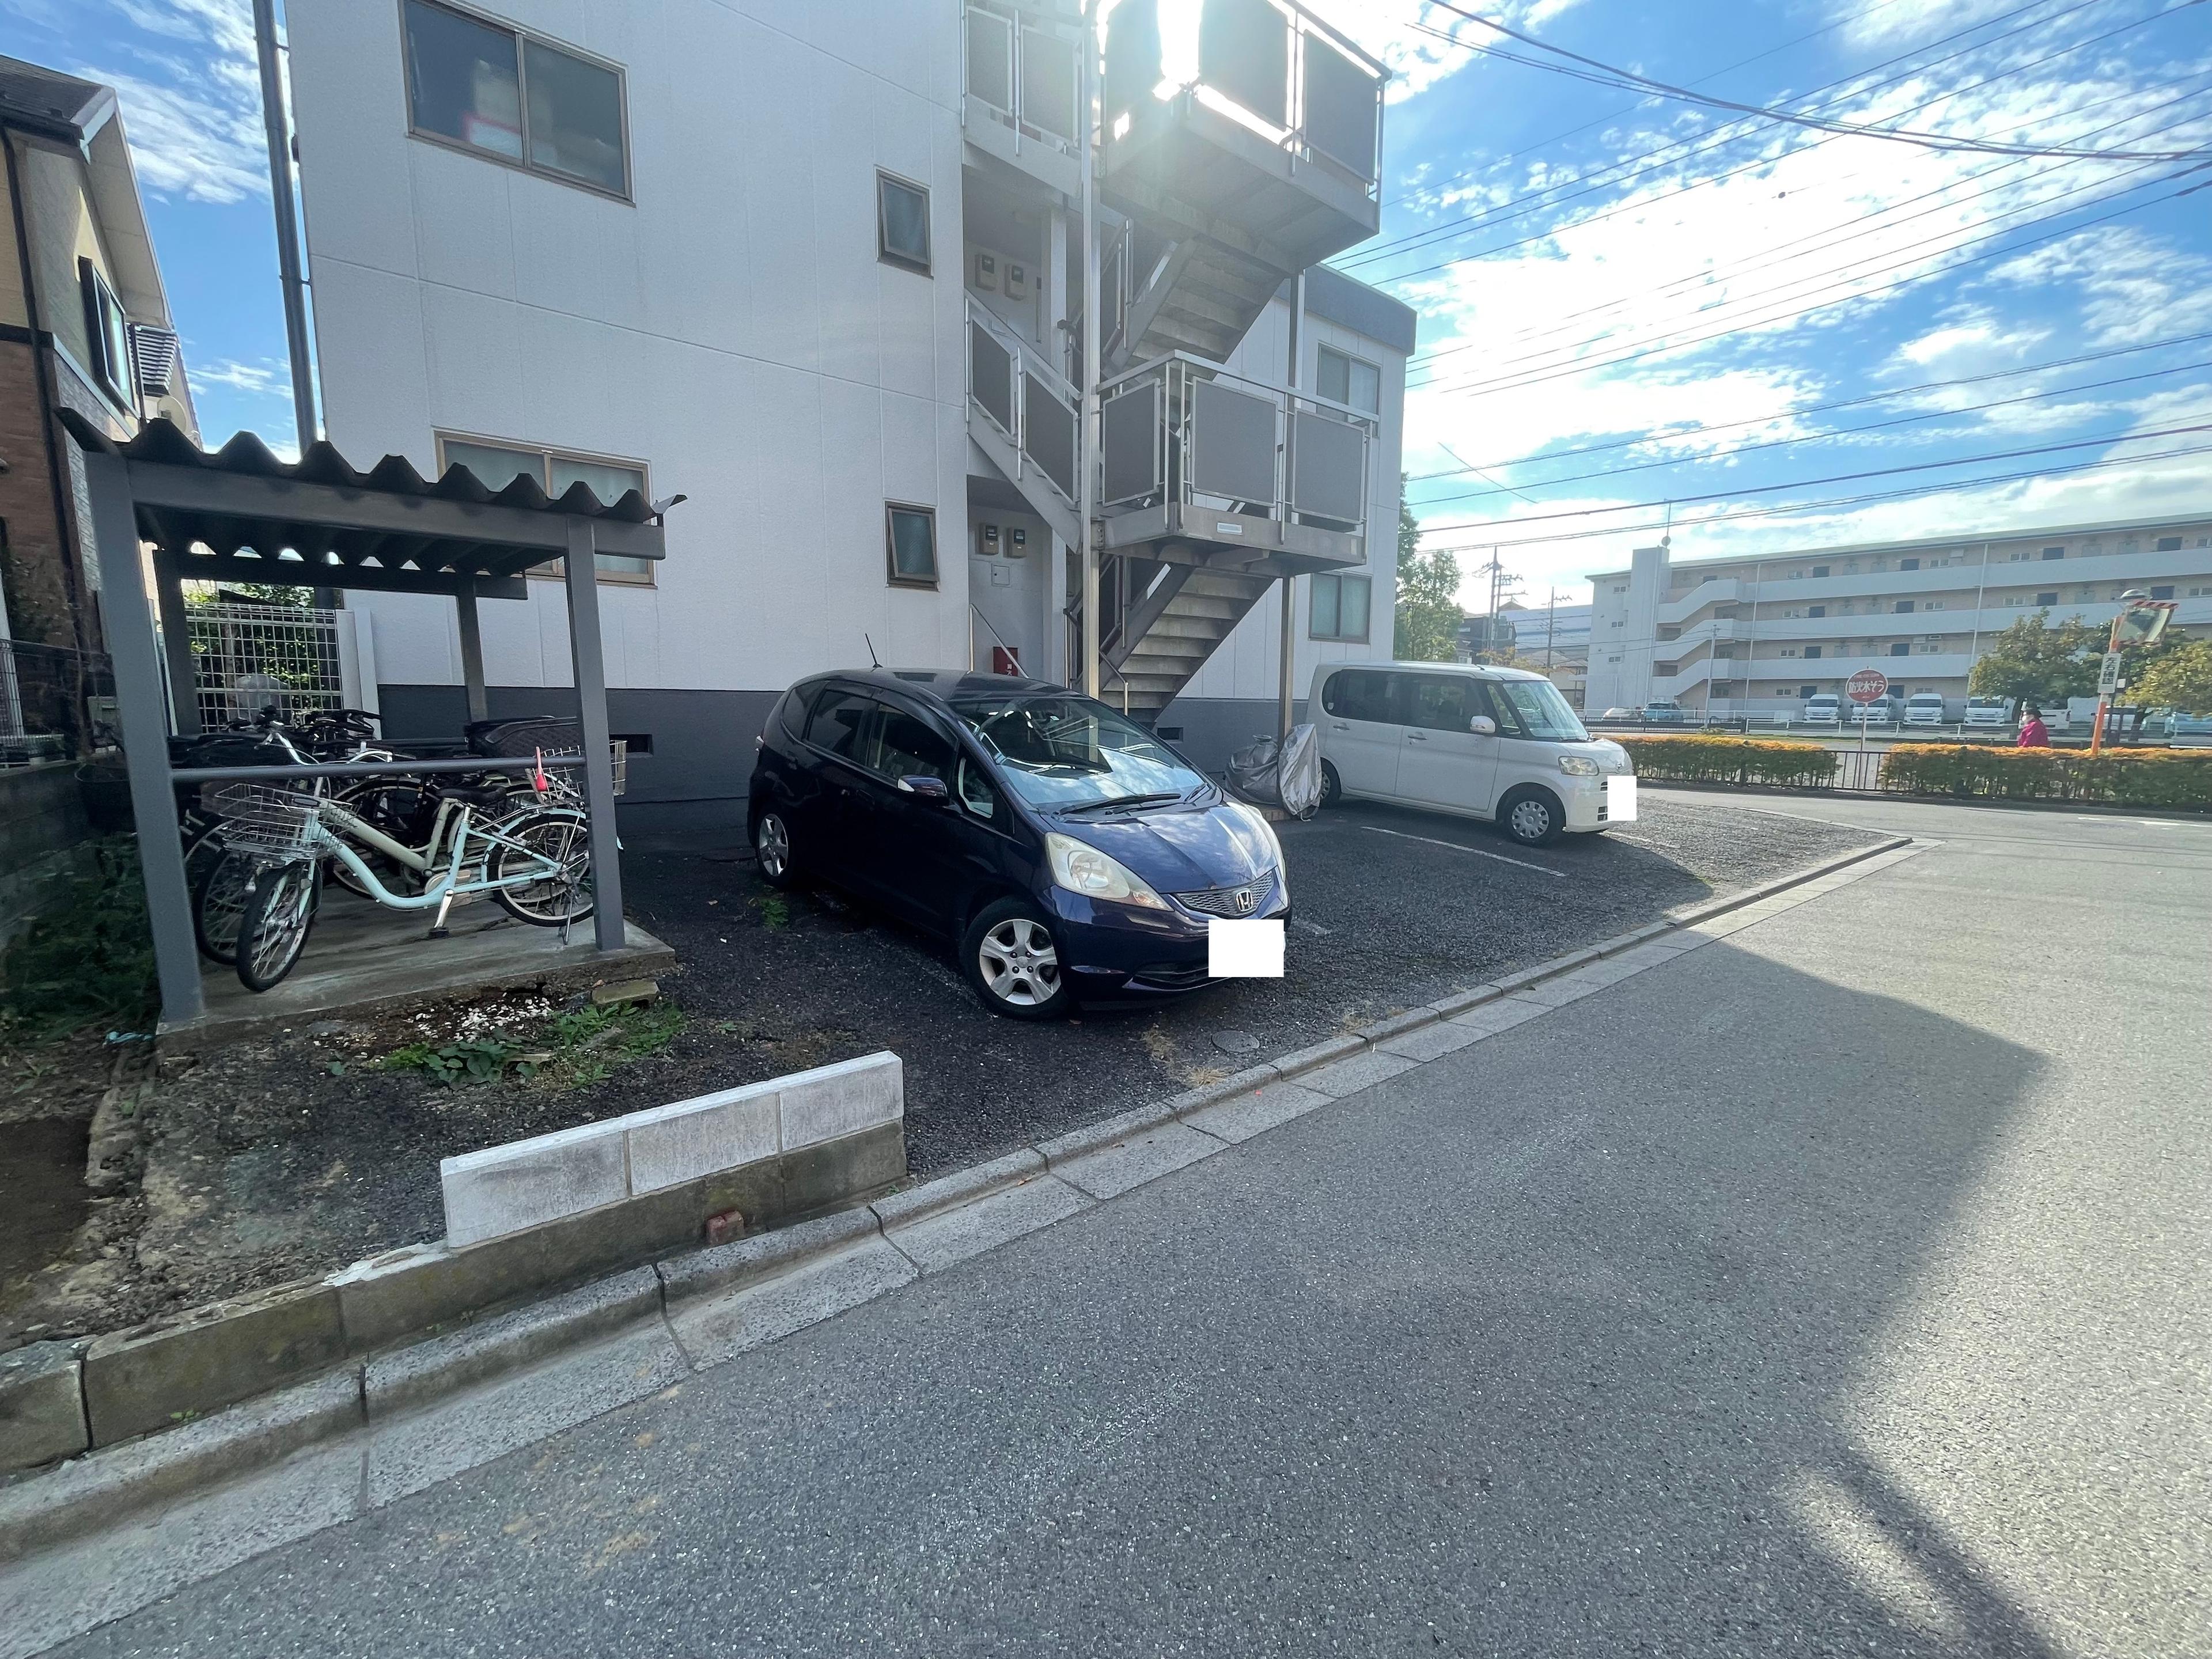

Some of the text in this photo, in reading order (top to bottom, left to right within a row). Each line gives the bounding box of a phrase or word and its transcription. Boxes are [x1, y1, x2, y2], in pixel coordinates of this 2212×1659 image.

[1849, 680, 1884, 693] 防火水そう
